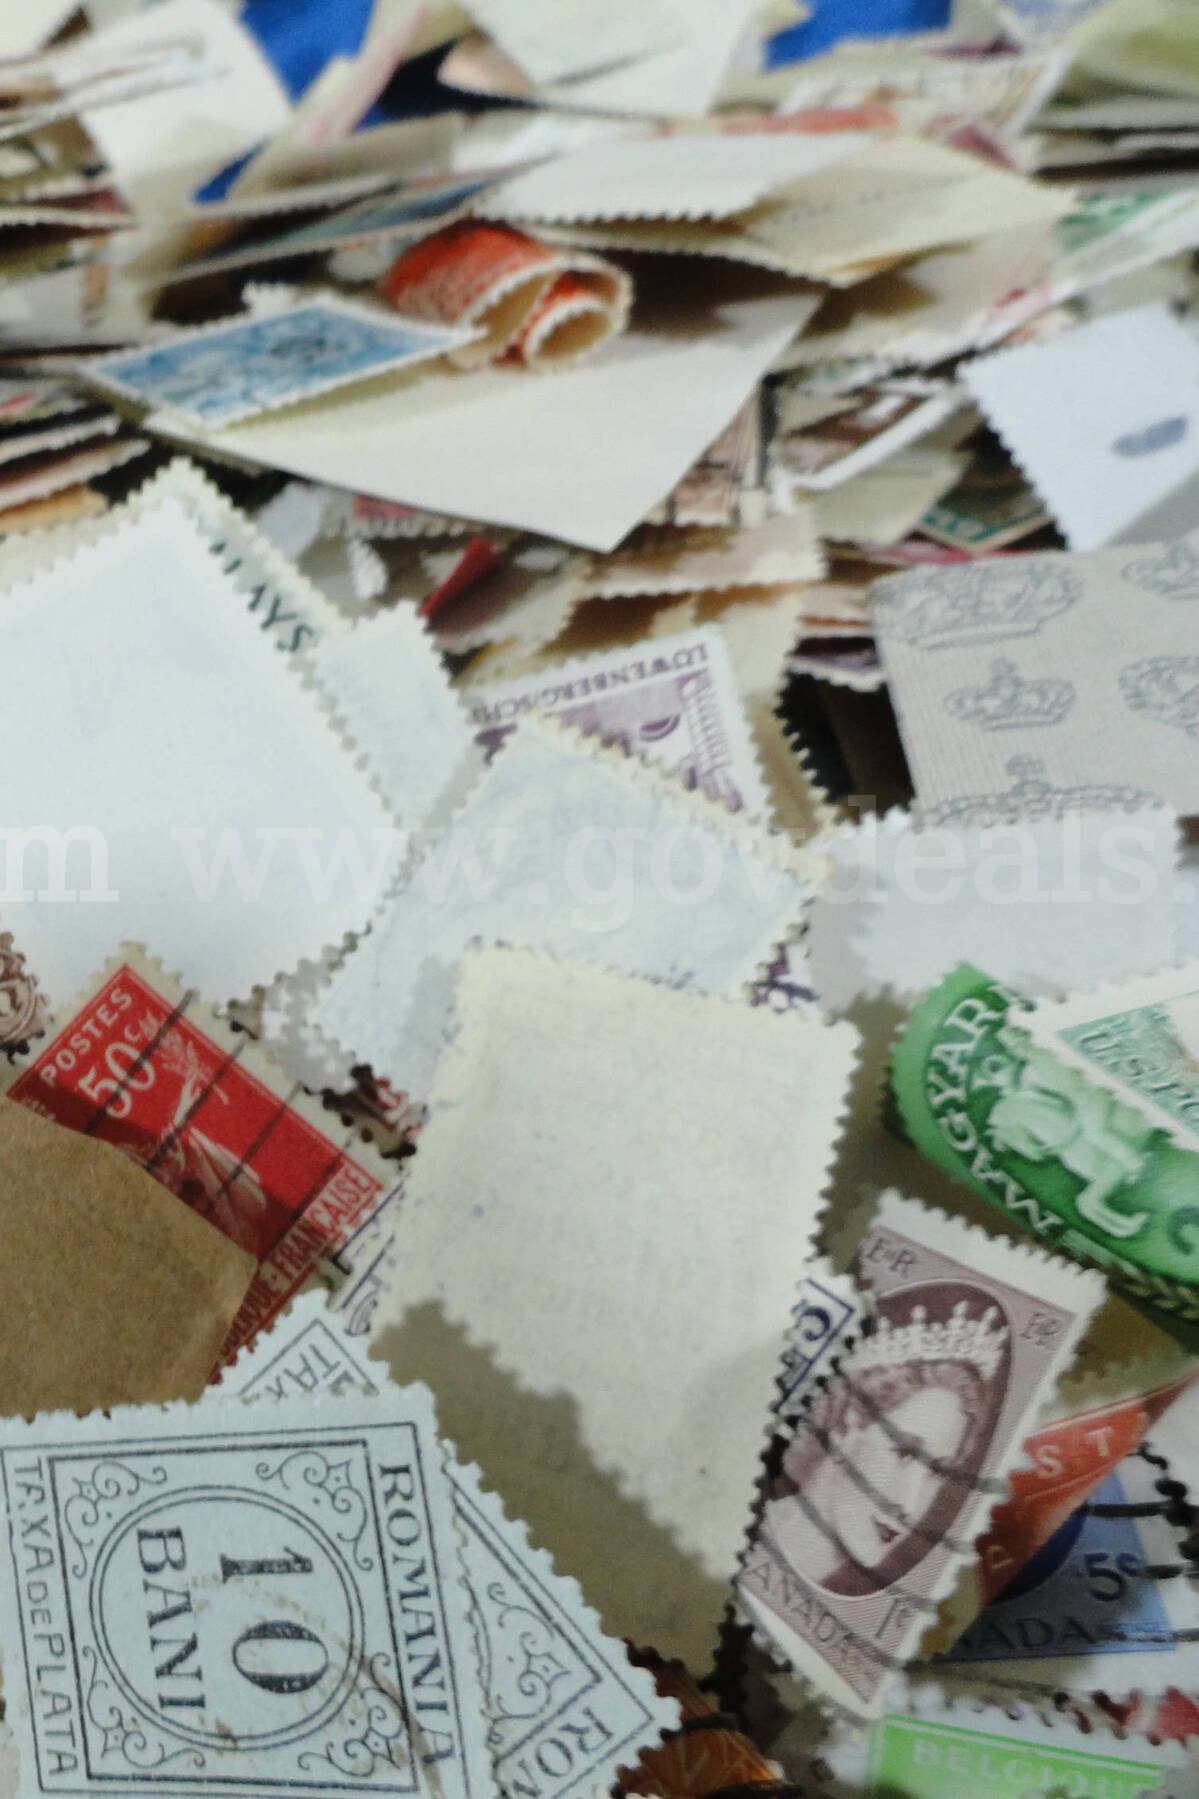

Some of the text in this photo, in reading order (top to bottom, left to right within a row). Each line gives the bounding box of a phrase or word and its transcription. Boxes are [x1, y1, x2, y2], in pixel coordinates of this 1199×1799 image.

[40, 985, 135, 1086] POSTES
[926, 997, 1063, 1236] MAGYAR
[11, 1457, 58, 1577] TAXA
[135, 1526, 207, 1710] BANI
[219, 1545, 329, 1694] 10
[377, 1463, 457, 1766] ROMANIA
[33, 1632, 80, 1777] PLATA
[911, 1739, 1130, 1799] BELGIQU
